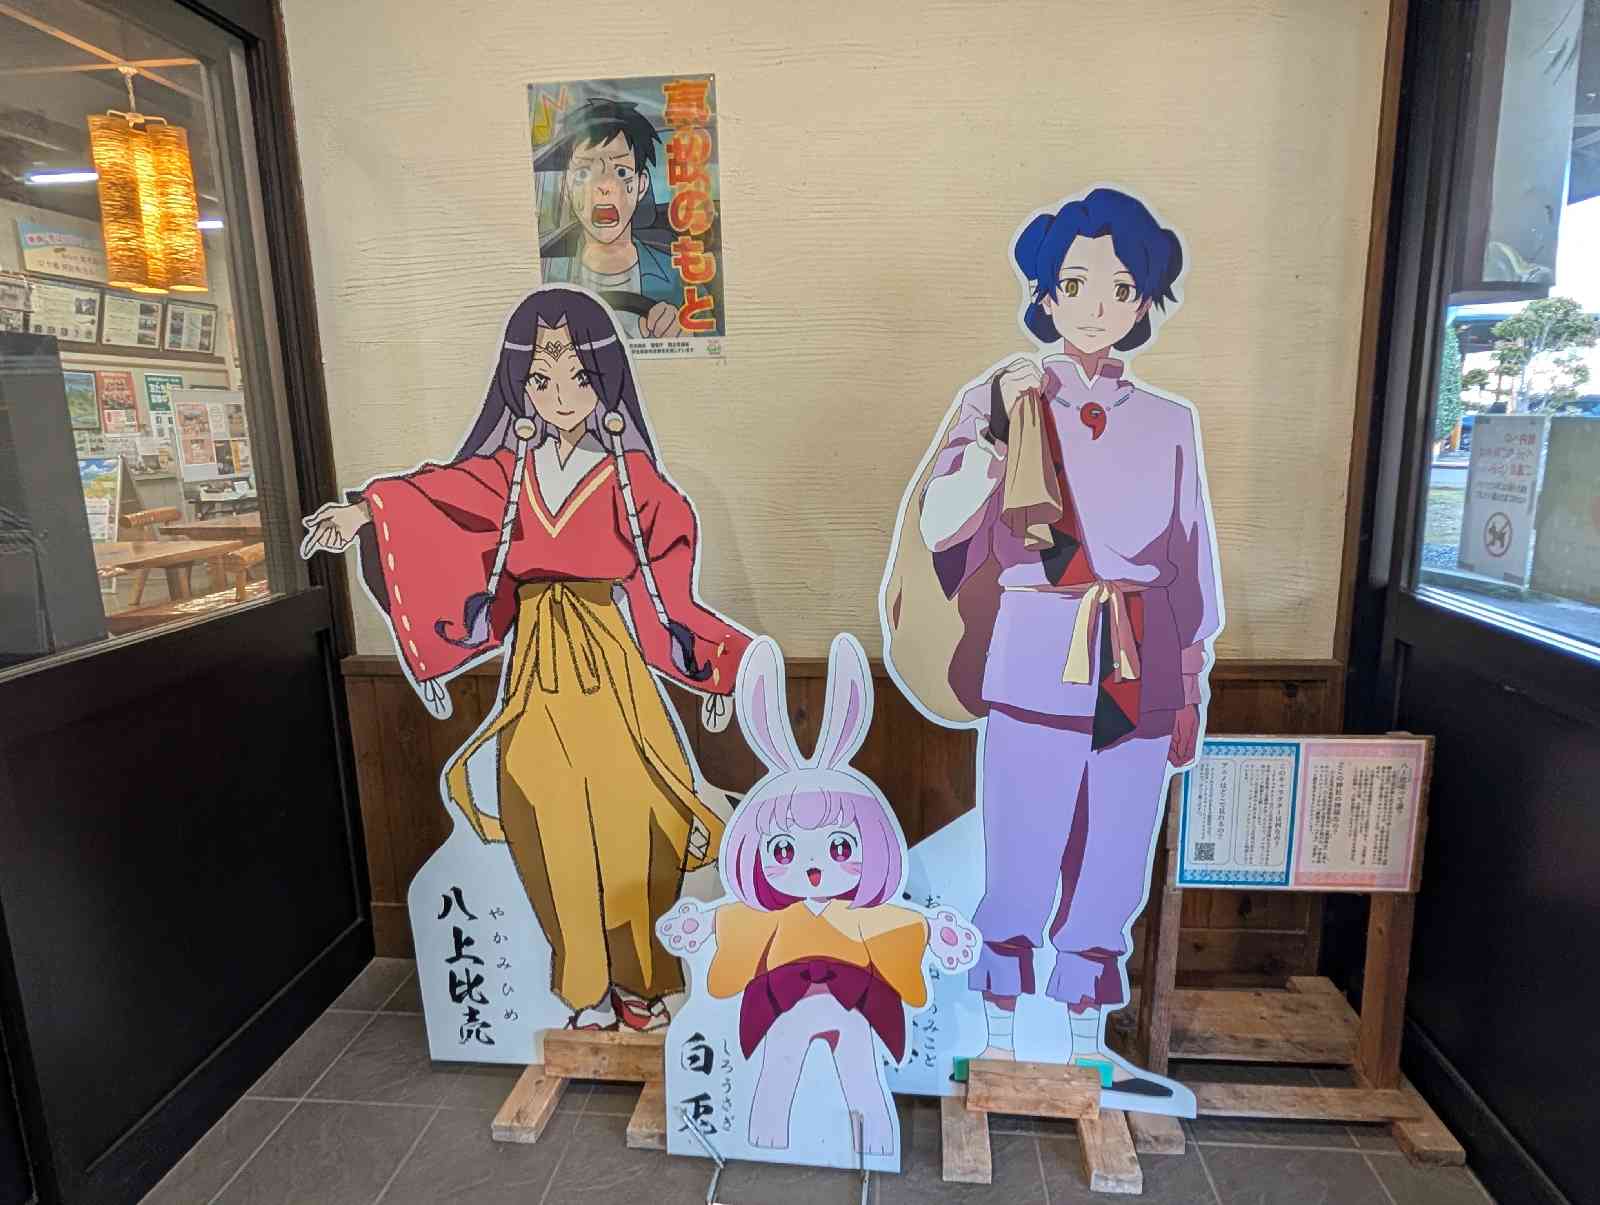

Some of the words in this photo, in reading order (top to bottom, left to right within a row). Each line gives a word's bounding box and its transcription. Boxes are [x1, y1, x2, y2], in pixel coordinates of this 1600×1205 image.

[488, 906, 519, 1022] やかみひめ
[720, 1038, 735, 1132] しろうさぎ
